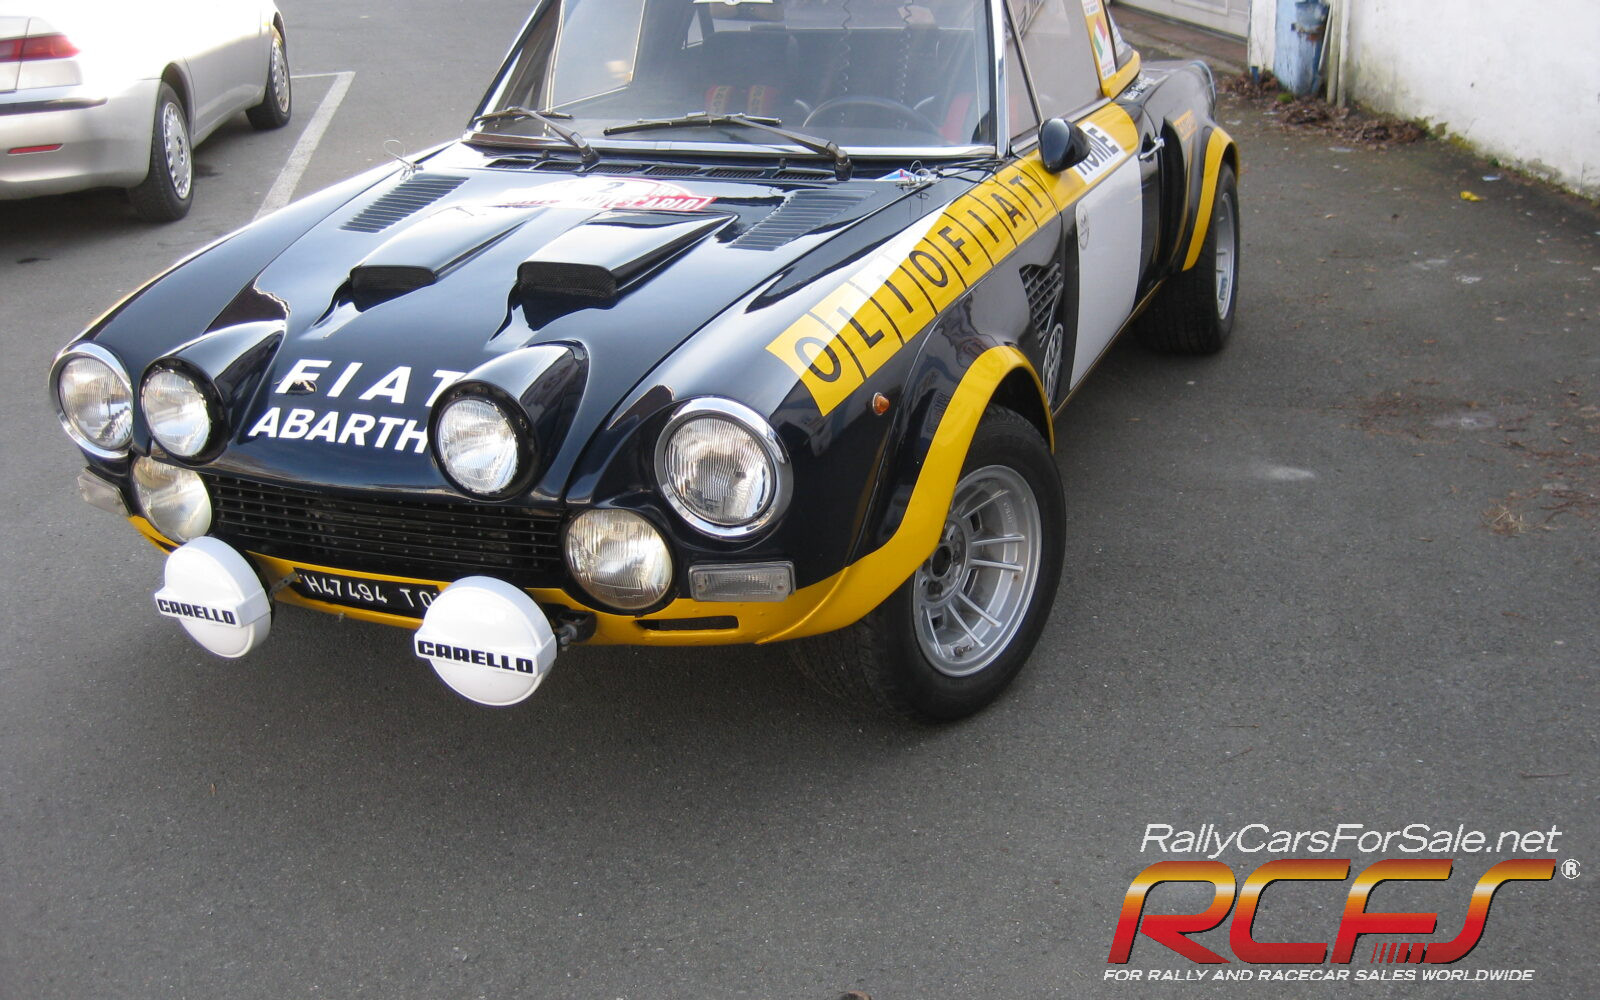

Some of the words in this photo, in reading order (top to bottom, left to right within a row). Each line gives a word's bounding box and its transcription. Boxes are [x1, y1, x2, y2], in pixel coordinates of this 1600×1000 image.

[275, 358, 467, 408] FIAT
[247, 406, 428, 454] ABARTH
[157, 598, 237, 625] CARELLO
[418, 640, 534, 674] CARELLO
